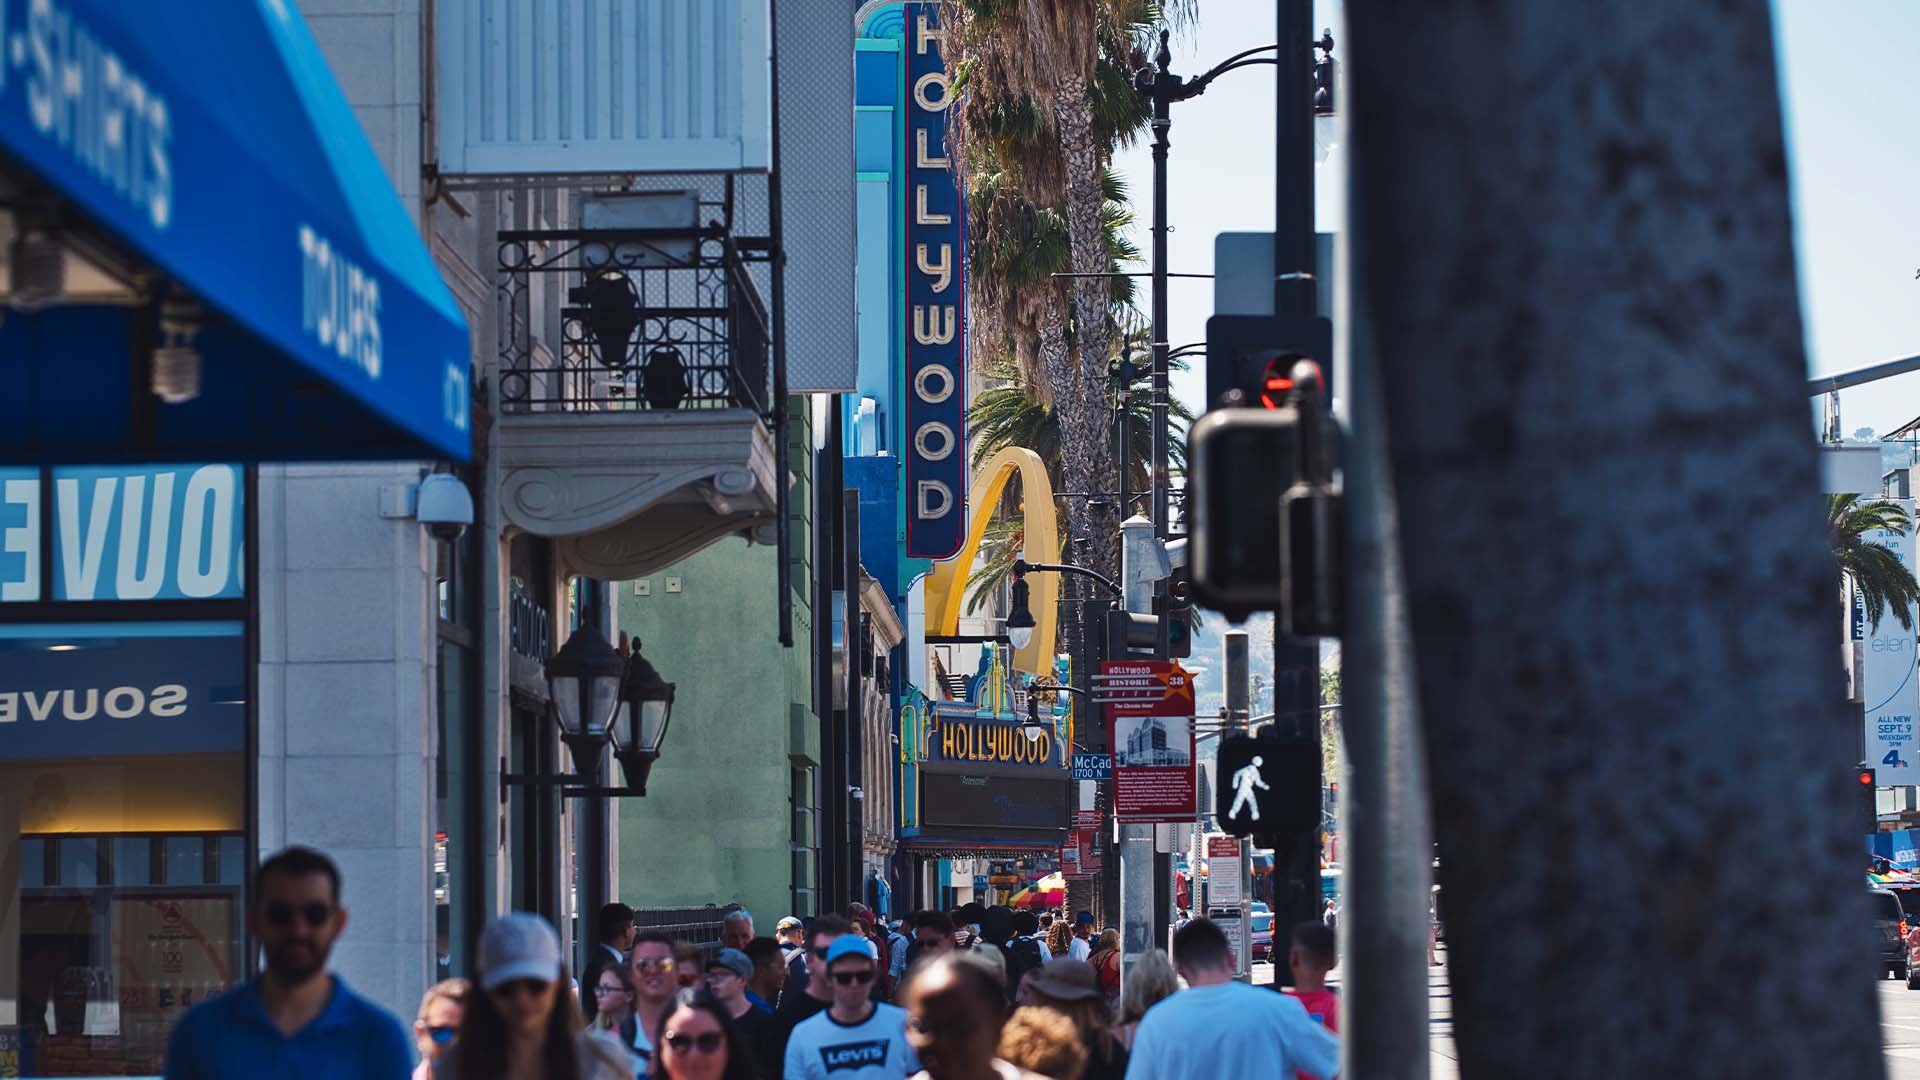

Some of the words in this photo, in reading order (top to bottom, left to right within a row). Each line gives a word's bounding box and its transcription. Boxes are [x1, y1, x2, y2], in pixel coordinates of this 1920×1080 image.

[0, 0, 173, 231] -SHIRTS
[914, 14, 955, 520] HOLLYWOOD
[300, 224, 382, 379] TOURS
[1885, 540, 1899, 548] fun
[1871, 635, 1912, 653] ellen
[1169, 676, 1184, 686] 38
[1893, 715, 1911, 723] NEW
[1878, 724, 1903, 733] SEPT.
[1906, 724, 1912, 733] 9
[942, 722, 1051, 765] HOLLYWOOD
[1882, 750, 1899, 768] 4
[1075, 769, 1093, 778] 1700
[1096, 769, 1103, 778] N
